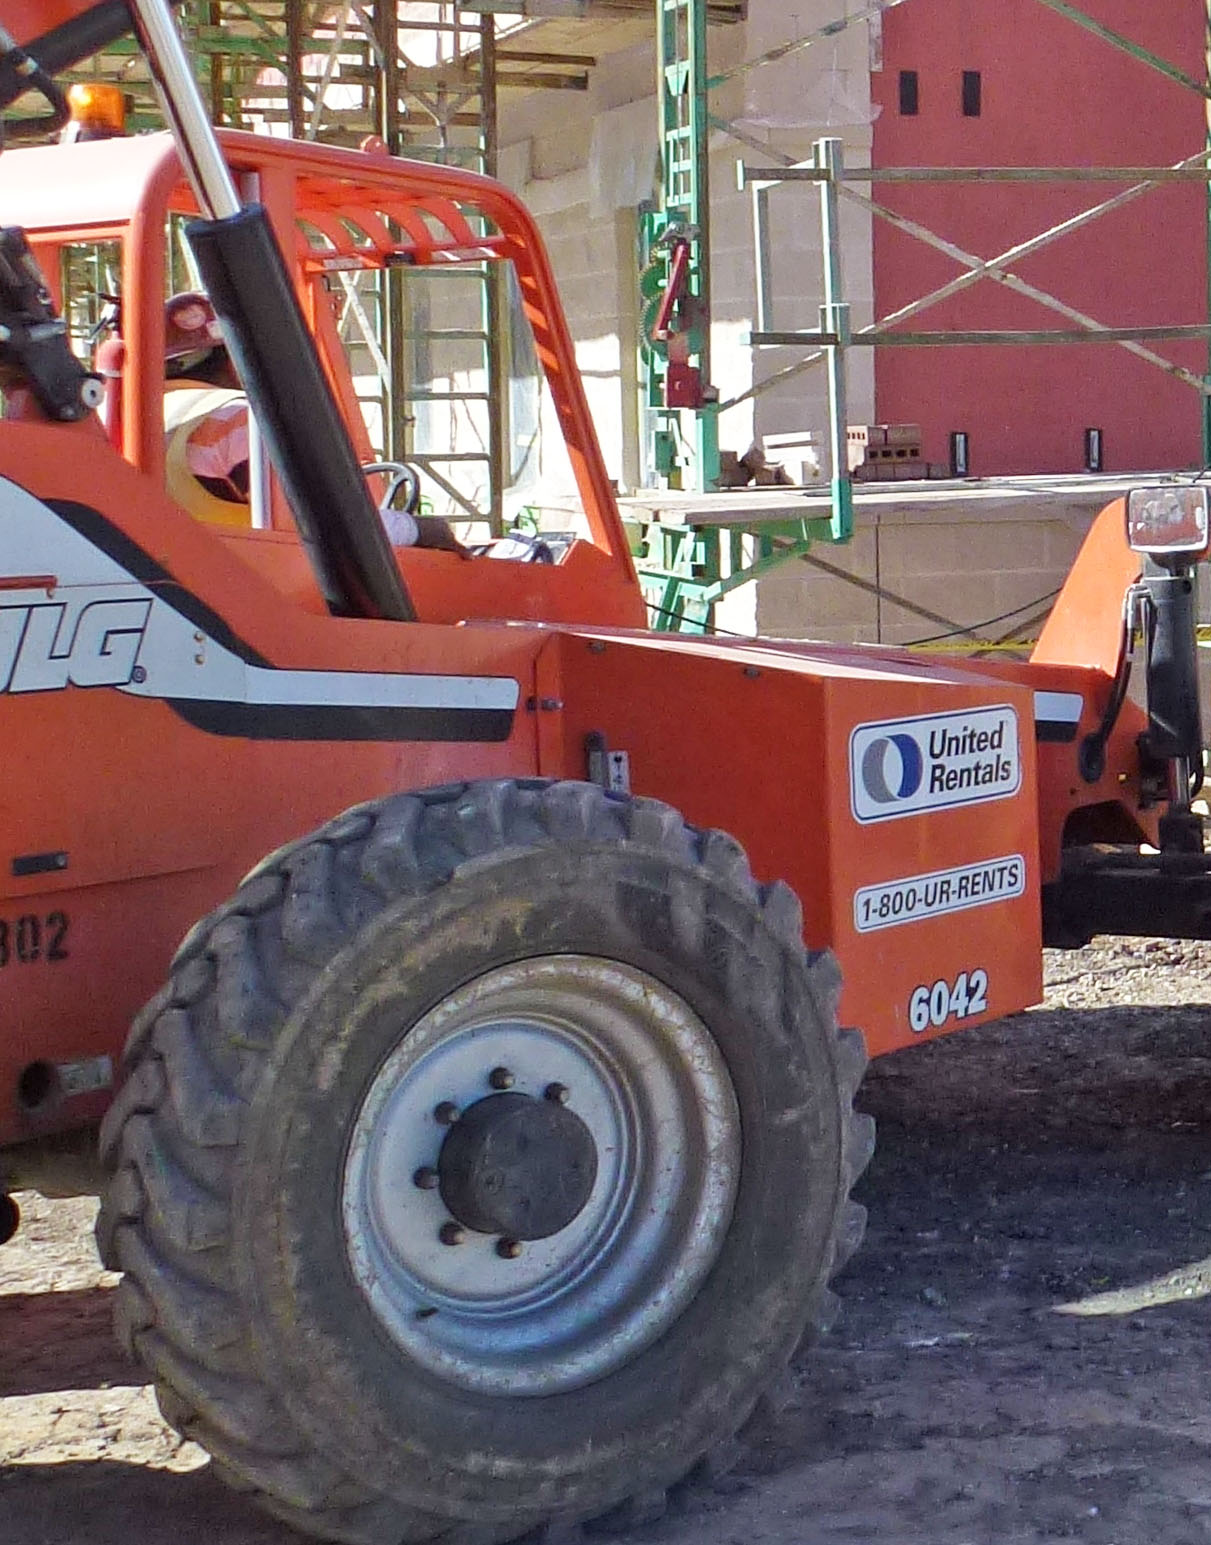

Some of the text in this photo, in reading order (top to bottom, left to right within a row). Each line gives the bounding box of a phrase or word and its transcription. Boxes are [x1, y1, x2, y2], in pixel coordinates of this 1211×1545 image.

[929, 721, 1004, 760] United
[929, 753, 1012, 794] Rentals
[862, 863, 1019, 922] 1-800-UR-RENTS
[909, 968, 989, 1033] 6042
